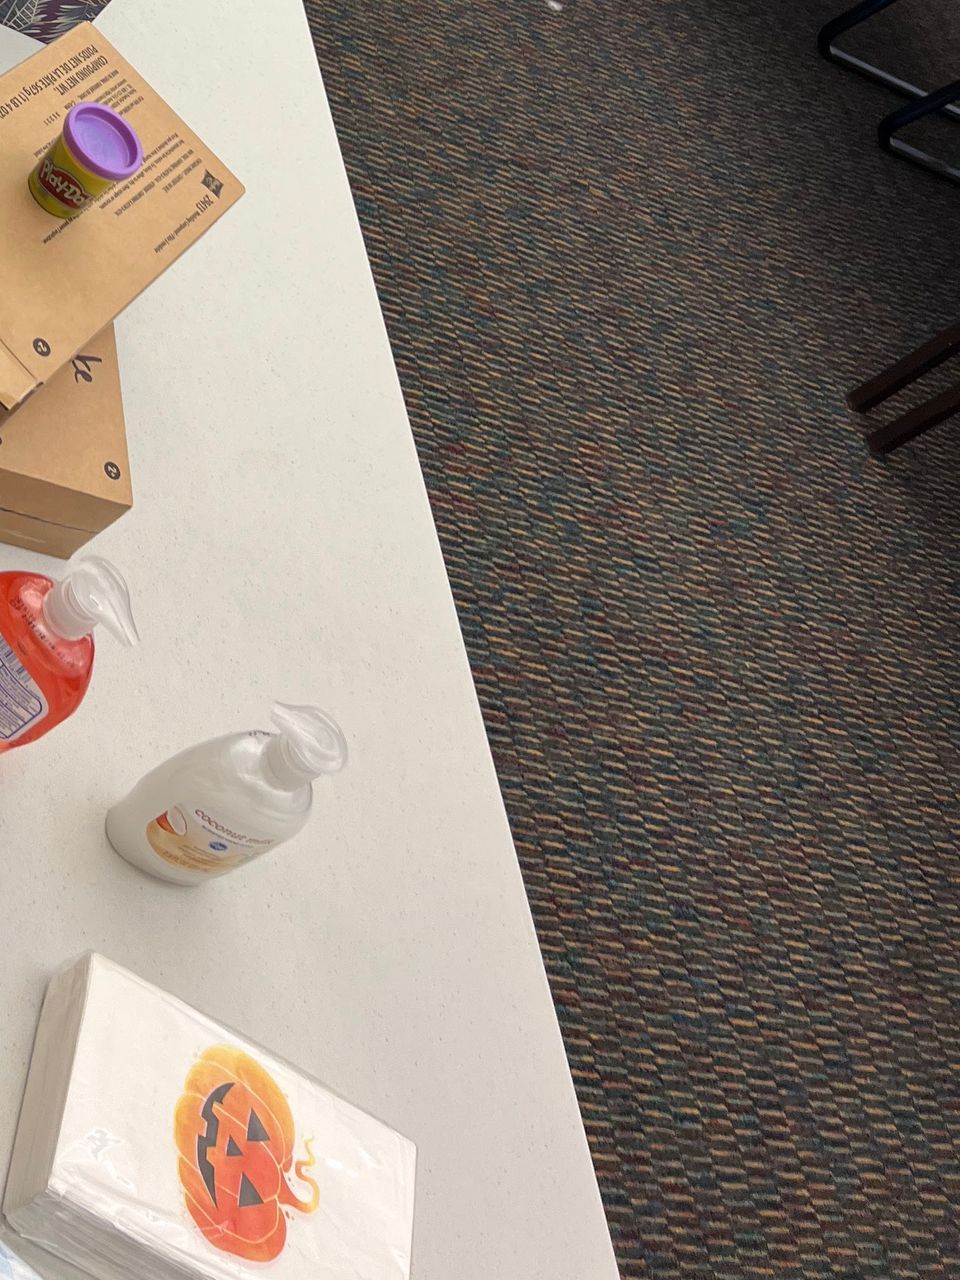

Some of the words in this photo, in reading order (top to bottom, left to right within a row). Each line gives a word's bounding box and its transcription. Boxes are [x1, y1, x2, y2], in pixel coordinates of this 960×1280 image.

[67, 54, 82, 69] NET
[79, 44, 99, 62] POIDS
[53, 67, 65, 79] LA
[60, 61, 71, 75] DE
[75, 55, 108, 81] COMPOUND
[22, 81, 43, 97] 567g
[65, 75, 81, 89] NET
[40, 159, 83, 206] Play-Do
[195, 194, 214, 213] 29413
[195, 808, 247, 843] coconut
